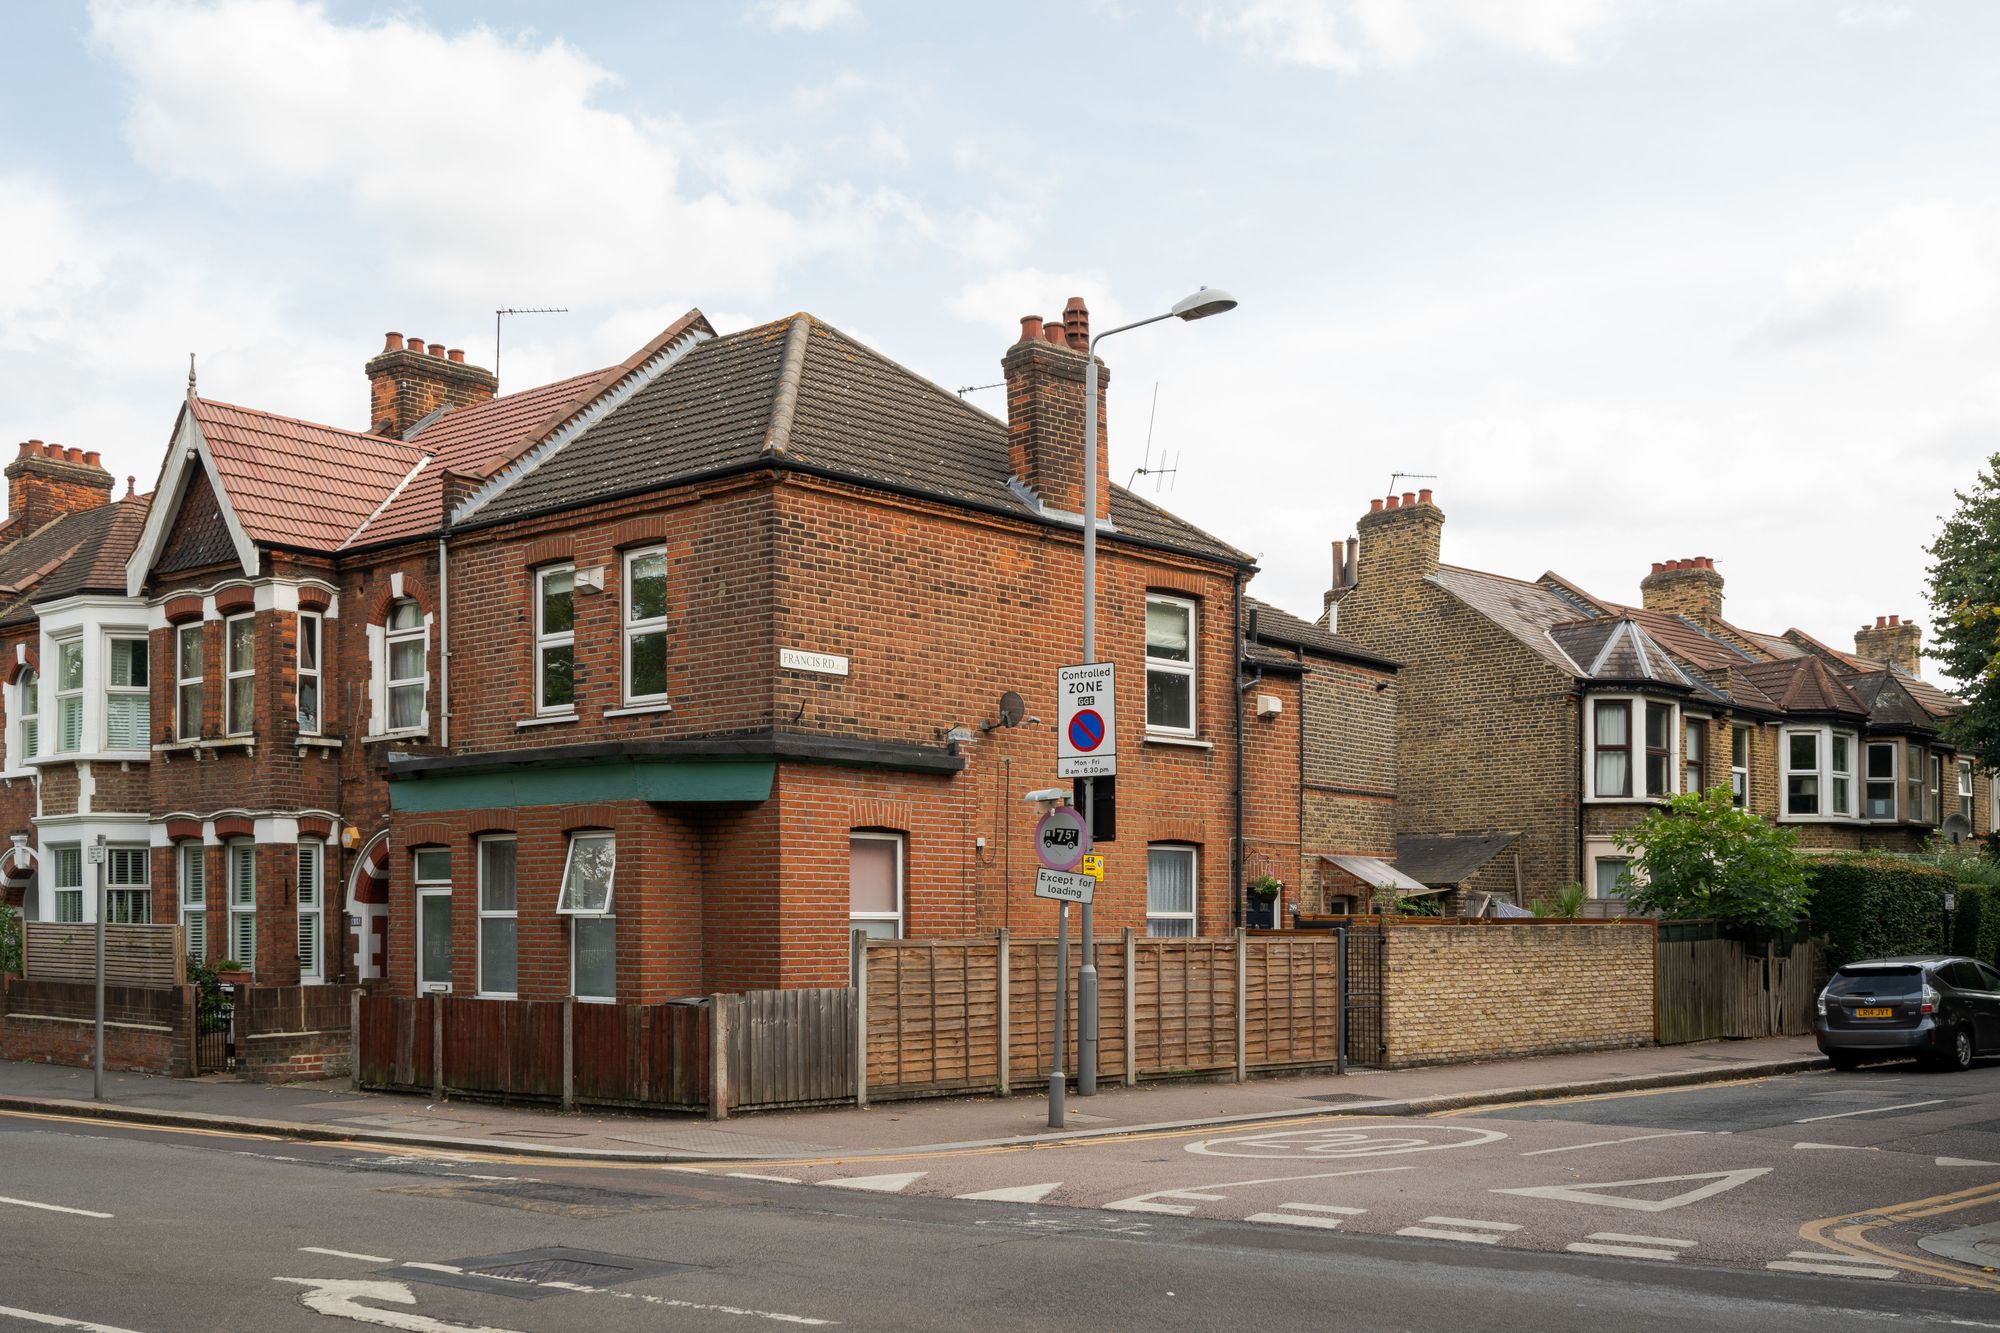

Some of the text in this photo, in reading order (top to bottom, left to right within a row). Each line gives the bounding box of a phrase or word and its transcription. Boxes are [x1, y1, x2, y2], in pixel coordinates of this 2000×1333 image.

[784, 653, 820, 667] FRANCIS
[1062, 668, 1110, 680] Controlled
[1069, 681, 1102, 693] ZONE
[1040, 872, 1074, 885] Except
[1079, 878, 1092, 887] for
[1047, 885, 1082, 898] loading
[1237, 1134, 1429, 1152] 20
